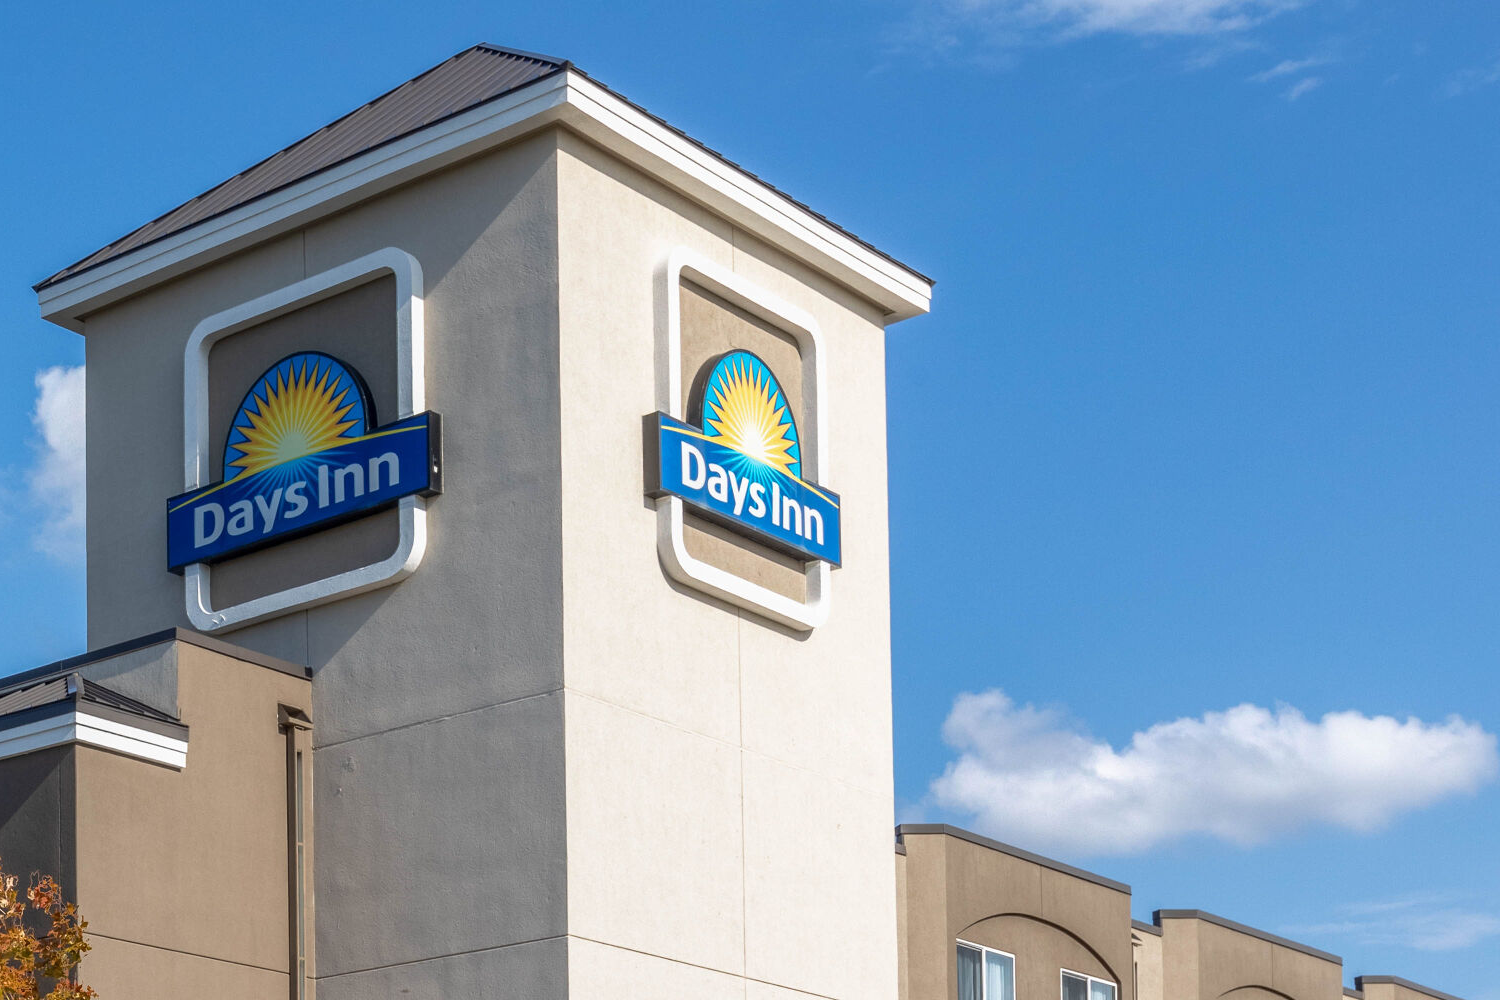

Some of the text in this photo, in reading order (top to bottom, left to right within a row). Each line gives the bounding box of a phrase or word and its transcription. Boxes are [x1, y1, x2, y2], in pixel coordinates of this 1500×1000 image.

[194, 452, 400, 548] Days Inn
[681, 440, 825, 546] Days Inn
